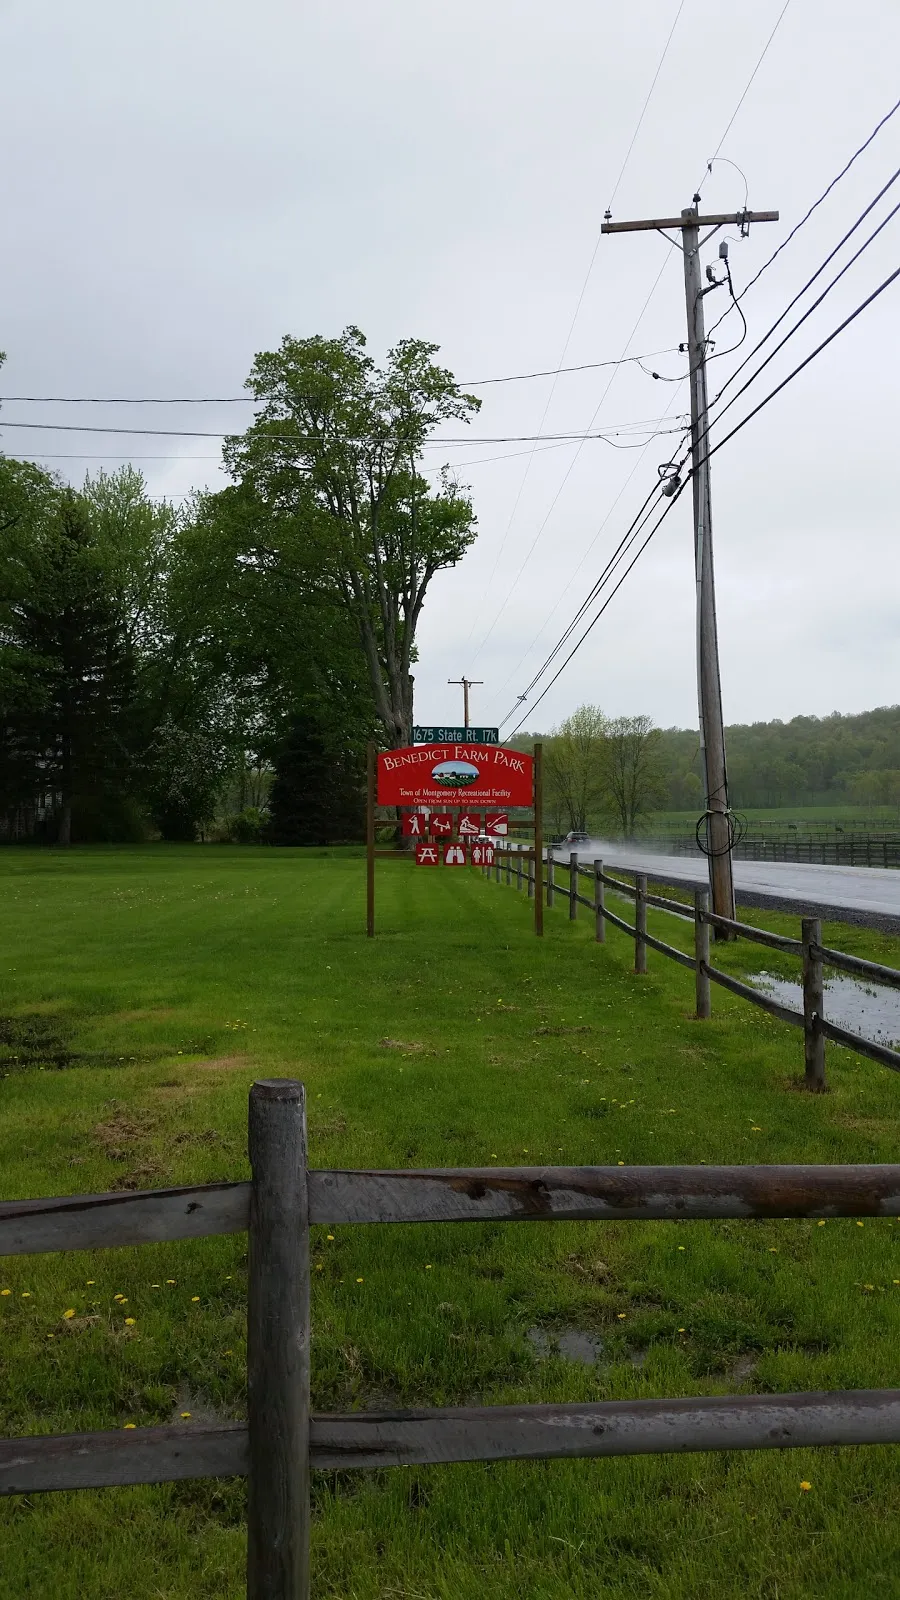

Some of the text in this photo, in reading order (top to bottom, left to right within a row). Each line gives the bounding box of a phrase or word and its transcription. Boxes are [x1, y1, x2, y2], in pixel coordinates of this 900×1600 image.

[413, 729, 433, 741] 1675
[438, 729, 462, 741] State
[466, 730, 478, 741] Rt.
[399, 788, 511, 798] Town of Montgomery Recreational Facility
